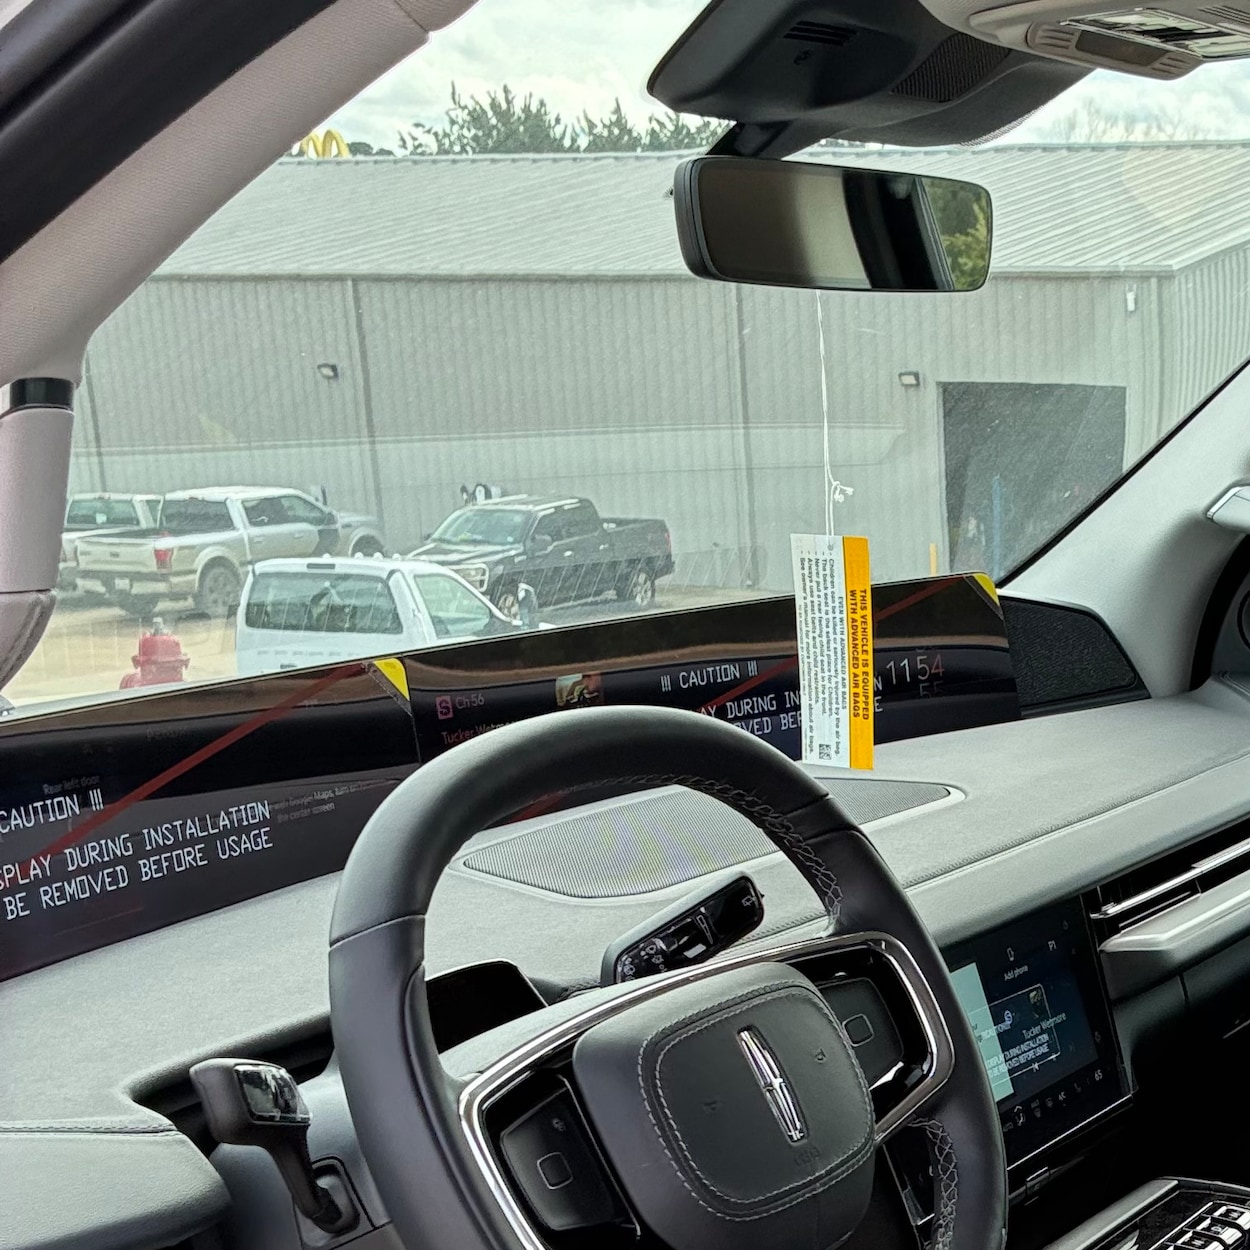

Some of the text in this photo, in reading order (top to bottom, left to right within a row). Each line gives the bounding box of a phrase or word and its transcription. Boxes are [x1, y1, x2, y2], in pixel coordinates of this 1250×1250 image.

[832, 606, 836, 614] be
[834, 707, 840, 715] by
[851, 617, 860, 669] ADVANCED
[679, 662, 740, 689] CAUTION
[862, 659, 869, 668] IS
[456, 693, 485, 709] Ch 56
[725, 694, 777, 719] DURING
[64, 833, 133, 872] DURING
[142, 800, 271, 850] INSTALLATION
[3, 827, 273, 920] BE REMOVED BEFORE USAGE
